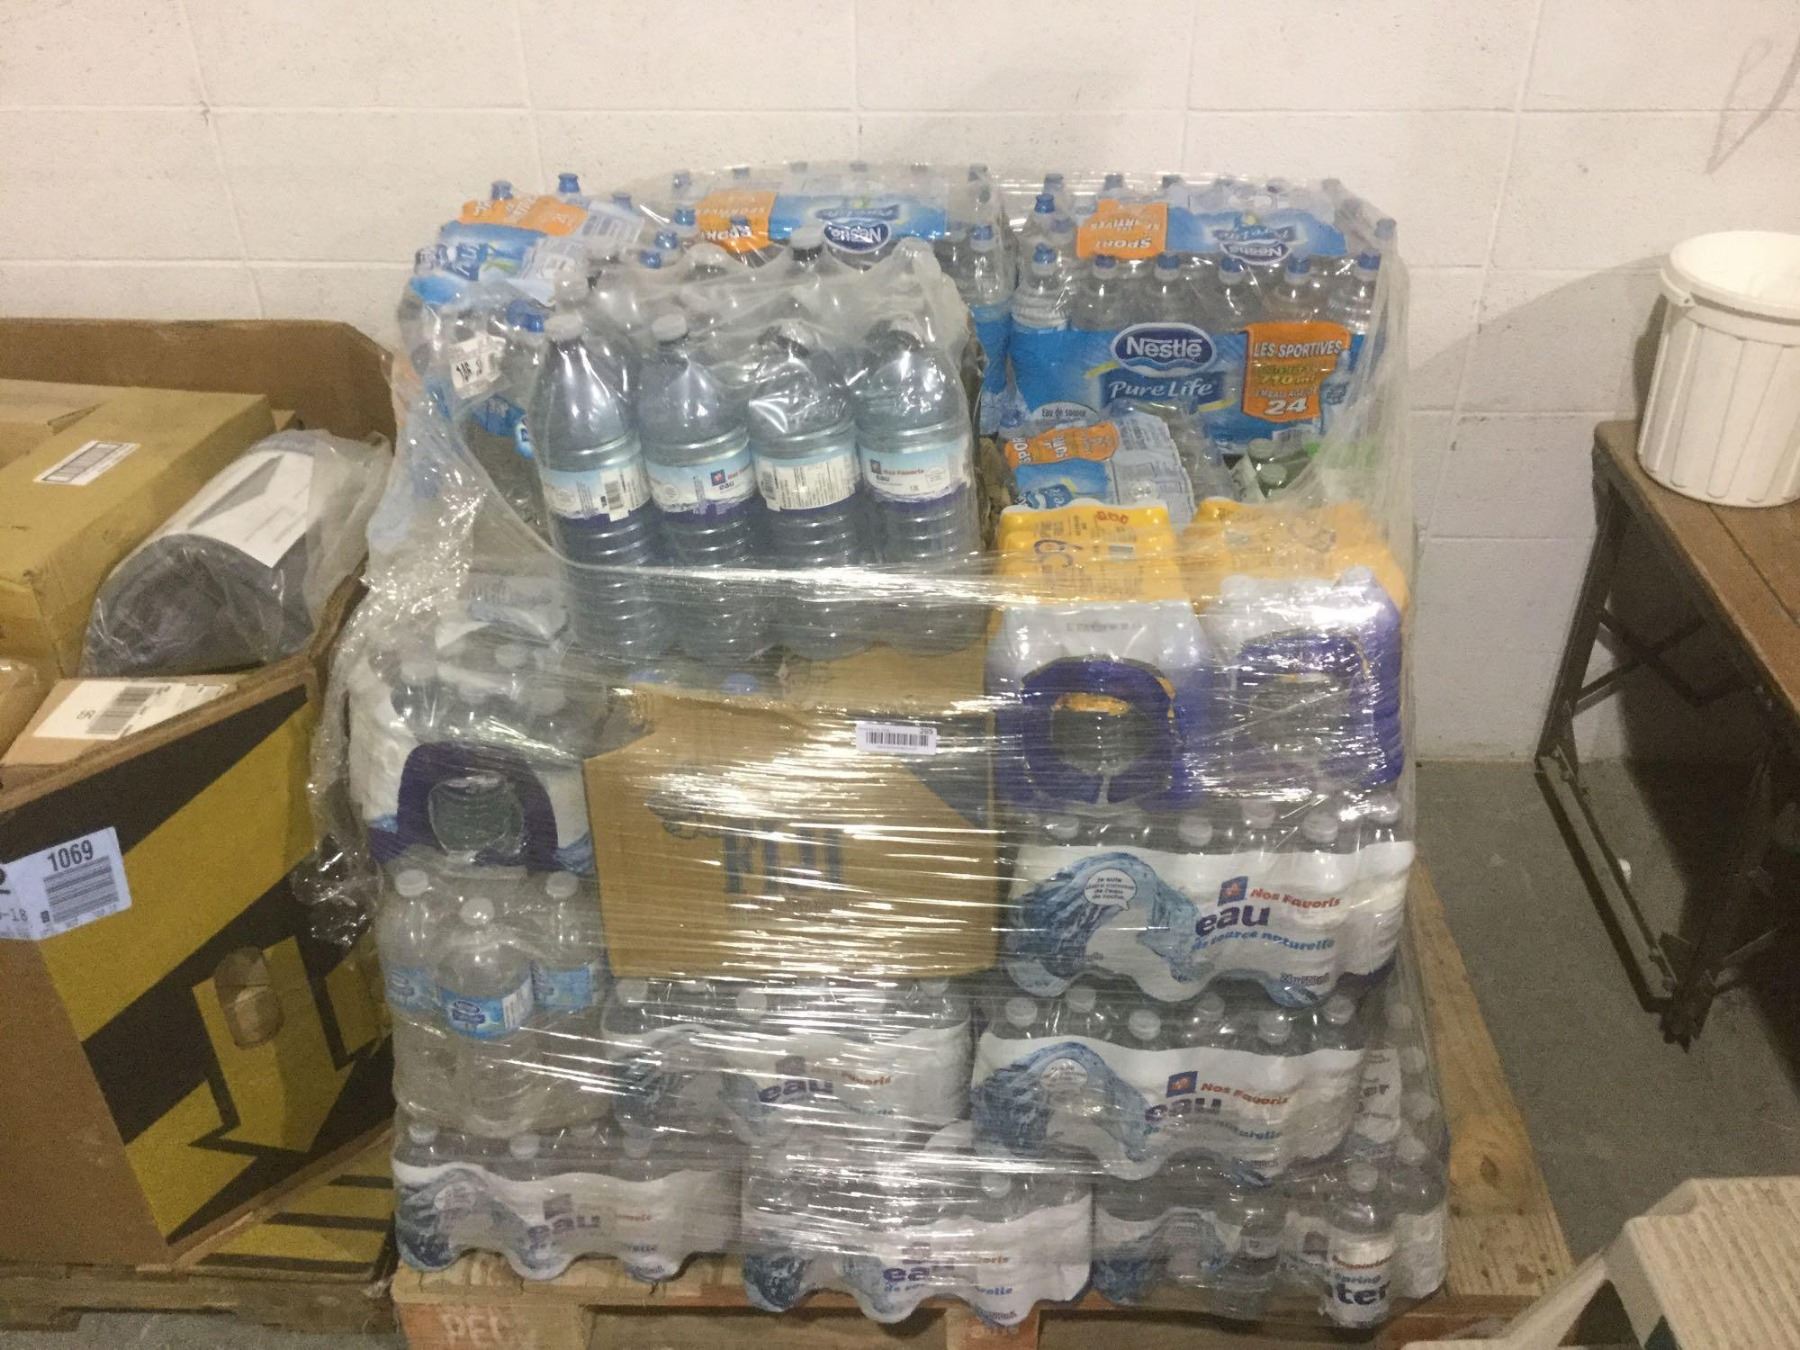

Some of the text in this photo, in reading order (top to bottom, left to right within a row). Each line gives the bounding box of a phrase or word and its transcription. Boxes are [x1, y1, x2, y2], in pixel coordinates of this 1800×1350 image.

[1126, 335, 1202, 359] Nestlé
[1253, 340, 1343, 358] LES SPORTIVES
[1108, 377, 1213, 399] Pure Life
[1264, 398, 1308, 416] 24
[47, 839, 94, 872] 1069
[1251, 888, 1341, 909] Nos Favoris
[1195, 906, 1270, 937] eau
[758, 1078, 834, 1103] eau
[1200, 1082, 1288, 1105] Nos Favoris
[1144, 1098, 1222, 1121] eau
